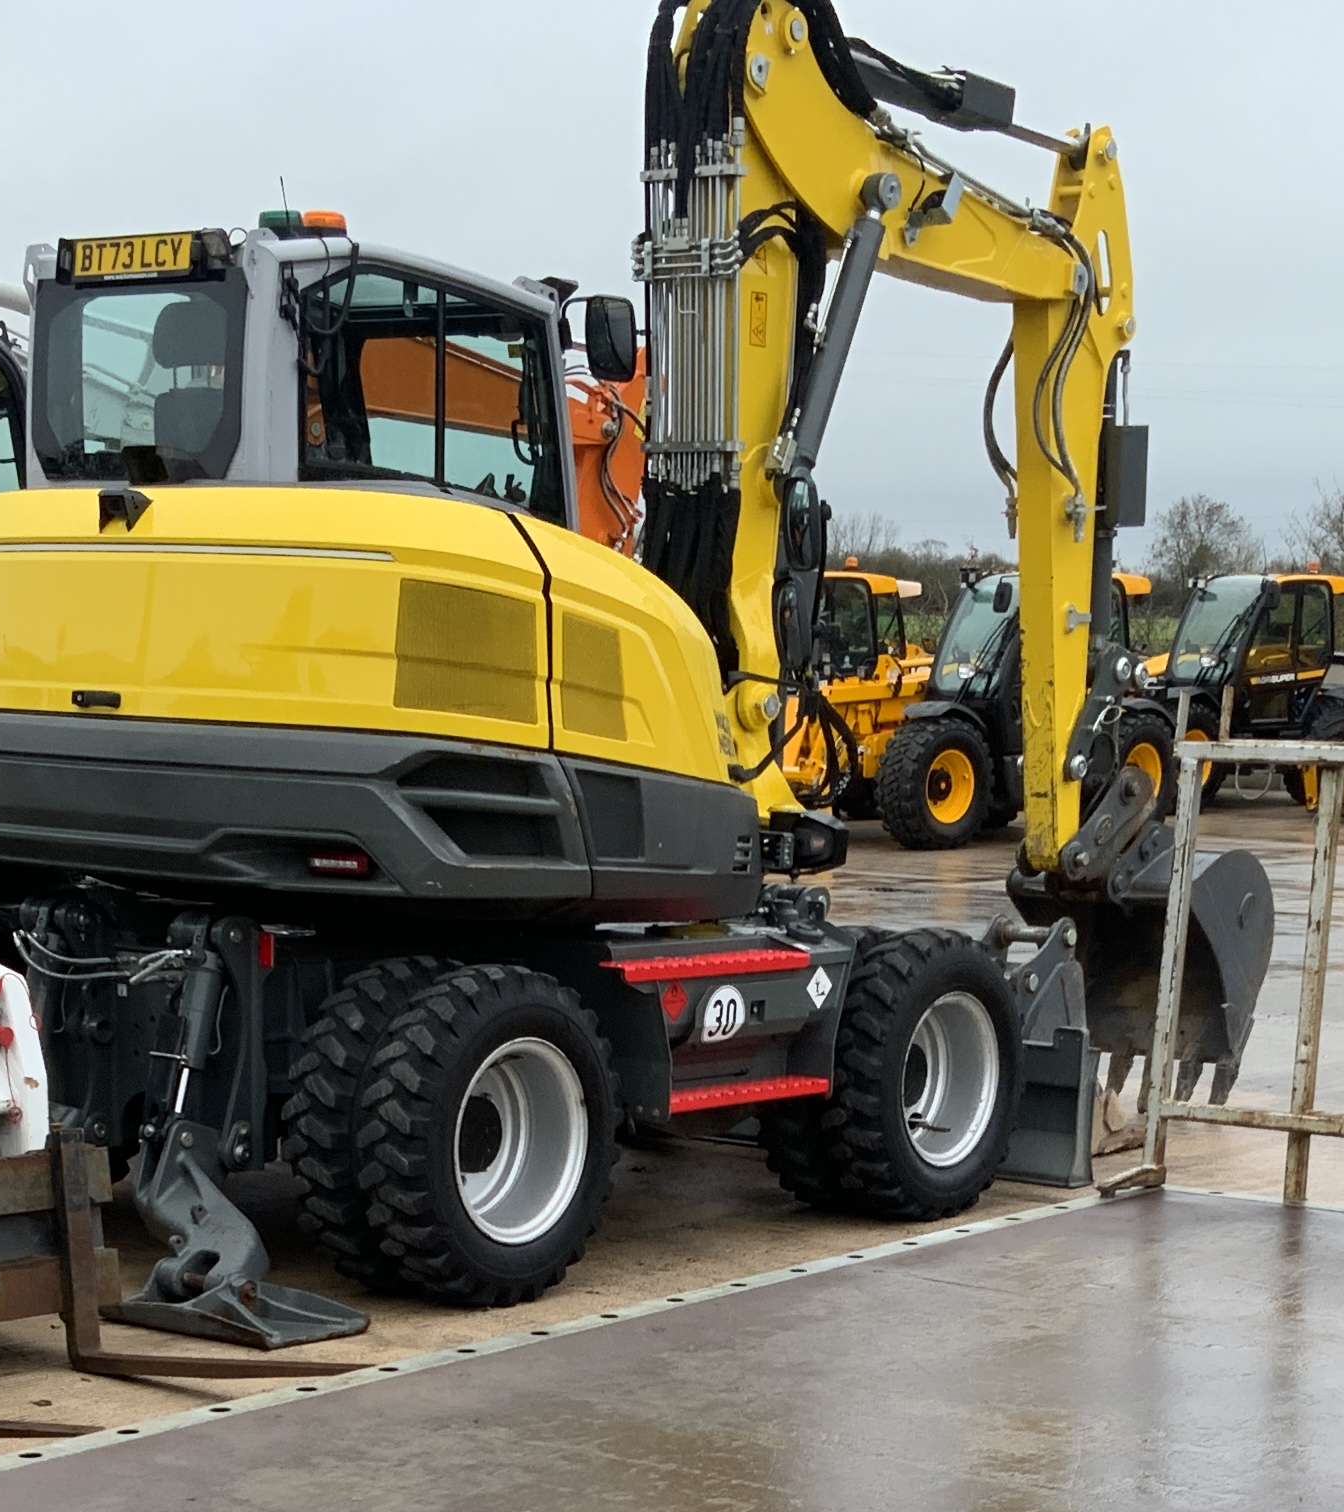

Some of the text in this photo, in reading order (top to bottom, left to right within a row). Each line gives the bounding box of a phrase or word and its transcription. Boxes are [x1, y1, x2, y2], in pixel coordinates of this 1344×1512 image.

[80, 237, 184, 272] BT73 LCY
[707, 998, 738, 1038] 30
